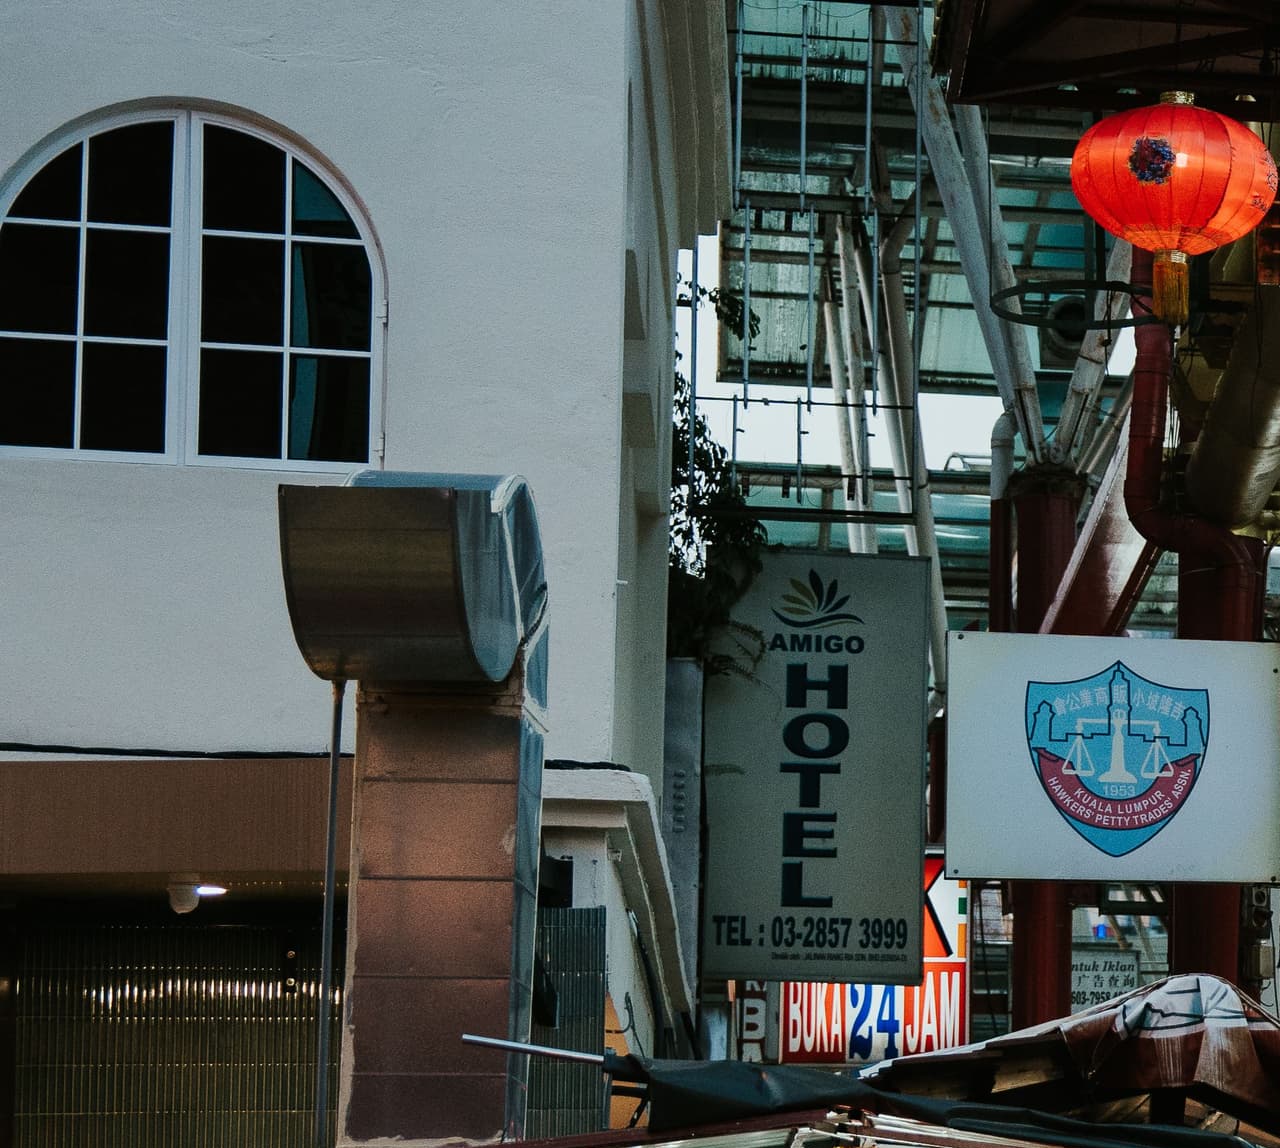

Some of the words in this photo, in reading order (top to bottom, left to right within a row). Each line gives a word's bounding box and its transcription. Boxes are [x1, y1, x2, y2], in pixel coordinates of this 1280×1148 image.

[769, 633, 866, 656] AMIGO
[780, 663, 851, 909] HOTEL
[1102, 784, 1136, 797] 1953
[1074, 788, 1113, 814] KUALA
[1117, 789, 1166, 814] LUMPUR
[1095, 812, 1131, 827] PETTY
[713, 915, 754, 947] TEL
[771, 916, 853, 948] 03-2857
[858, 917, 908, 949] 3999
[1072, 960, 1100, 973] ntuk
[1102, 960, 1135, 973] Iklan
[788, 981, 843, 1053] BUKA
[849, 983, 900, 1060] 24
[906, 971, 961, 1053] JAM
